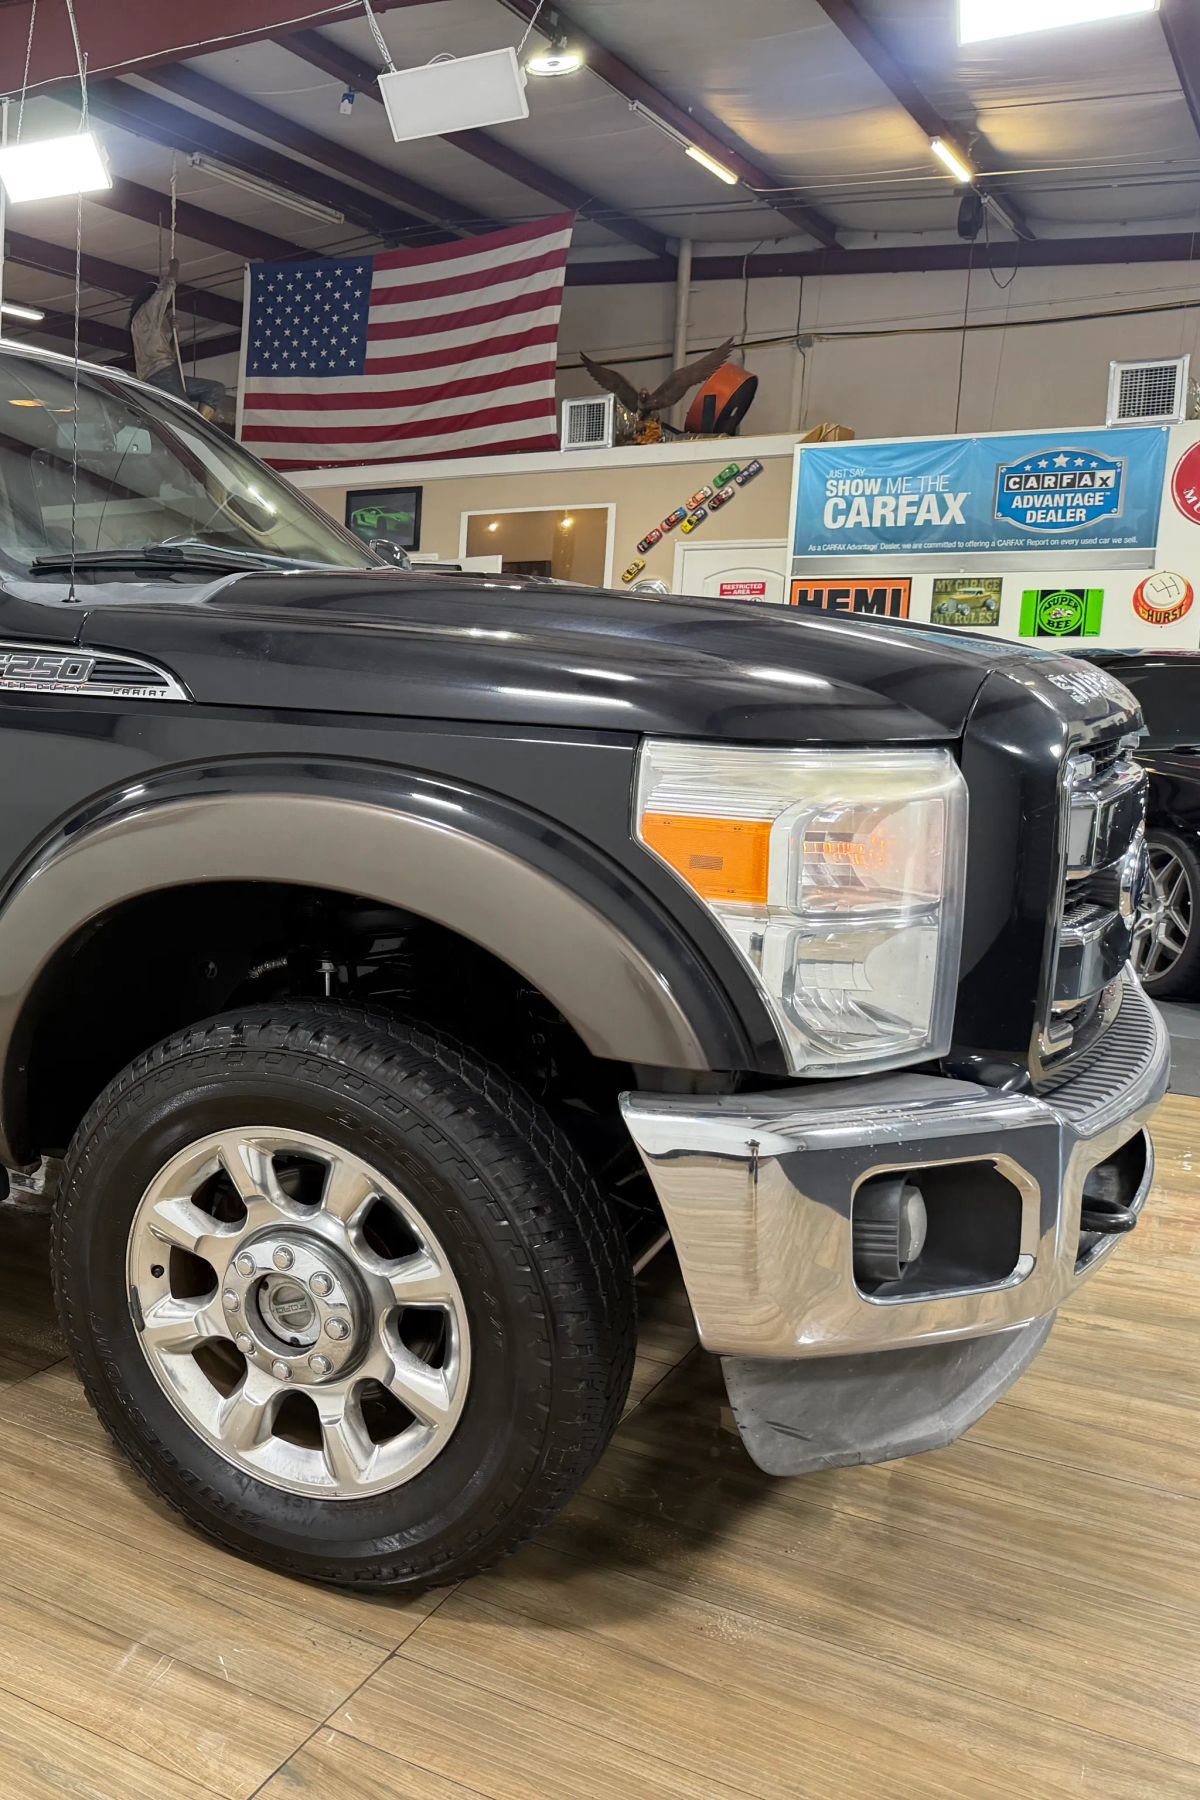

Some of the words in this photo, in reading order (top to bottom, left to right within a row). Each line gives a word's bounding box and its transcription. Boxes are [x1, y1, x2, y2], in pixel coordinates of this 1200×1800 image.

[826, 469, 847, 479] JUST
[849, 468, 866, 478] SAY
[825, 478, 882, 497] SHOW
[886, 477, 913, 494] ME
[918, 474, 950, 493] THE
[1008, 474, 1111, 490] CARFAX
[823, 493, 967, 530] CARFAX
[1025, 508, 1087, 524] DEALER
[808, 544, 816, 552] As
[822, 544, 846, 552] CARFAX
[924, 541, 956, 549] committed
[965, 540, 989, 549] offering
[1027, 538, 1049, 547] Report
[1060, 538, 1079, 547] every
[1080, 537, 1097, 545] used
[1123, 536, 1138, 544] sell.
[935, 580, 951, 592] MY
[1043, 596, 1080, 612] SUPER
[933, 612, 952, 625] MY
[955, 612, 998, 625] RULES!
[1147, 603, 1185, 623] HURST
[1046, 619, 1072, 628] BEE
[36, 683, 83, 692] DUTY
[112, 688, 168, 698] LARIAT
